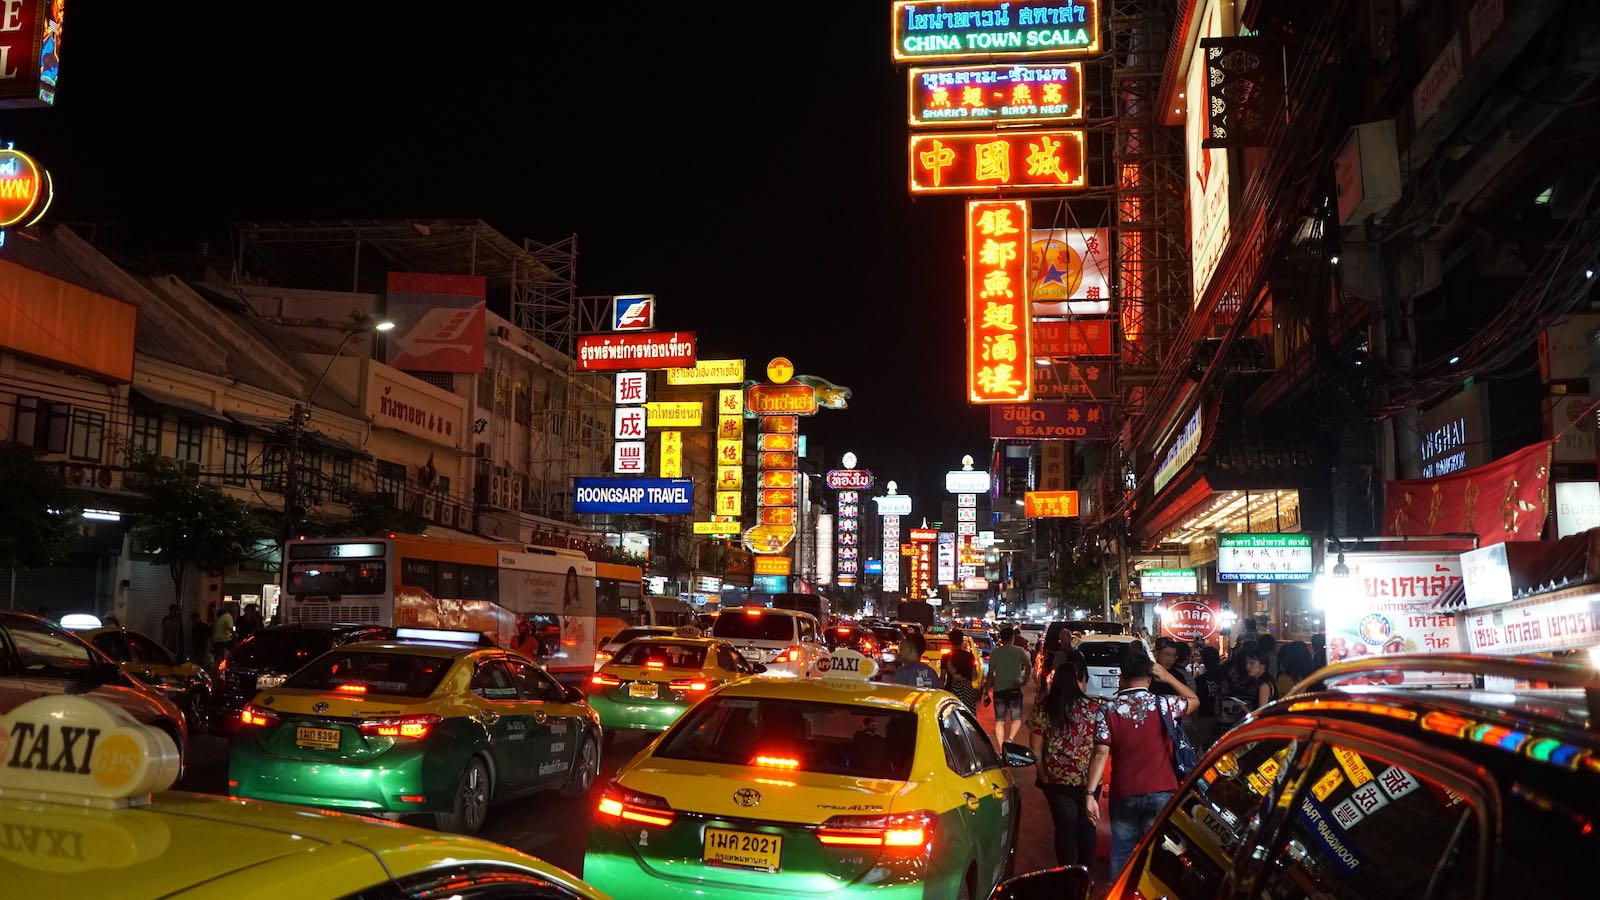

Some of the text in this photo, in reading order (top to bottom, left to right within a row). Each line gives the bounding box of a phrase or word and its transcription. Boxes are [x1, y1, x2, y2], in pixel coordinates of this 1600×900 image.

[903, 28, 1089, 52] CHINA TOWN SCALA
[923, 107, 968, 118] SHARK'S
[1001, 106, 1038, 115] BIRD'S
[1040, 104, 1068, 114] NEST
[919, 136, 1069, 187] 中國城
[618, 377, 642, 471] 振成豐
[1015, 425, 1087, 436] SEAFOOD
[577, 487, 689, 504] ROONGSARP TRAVEL
[327, 546, 340, 556] 73
[831, 656, 860, 671] TAXI
[8, 721, 101, 775] TAXI
[710, 833, 777, 854] 1มค 2021
